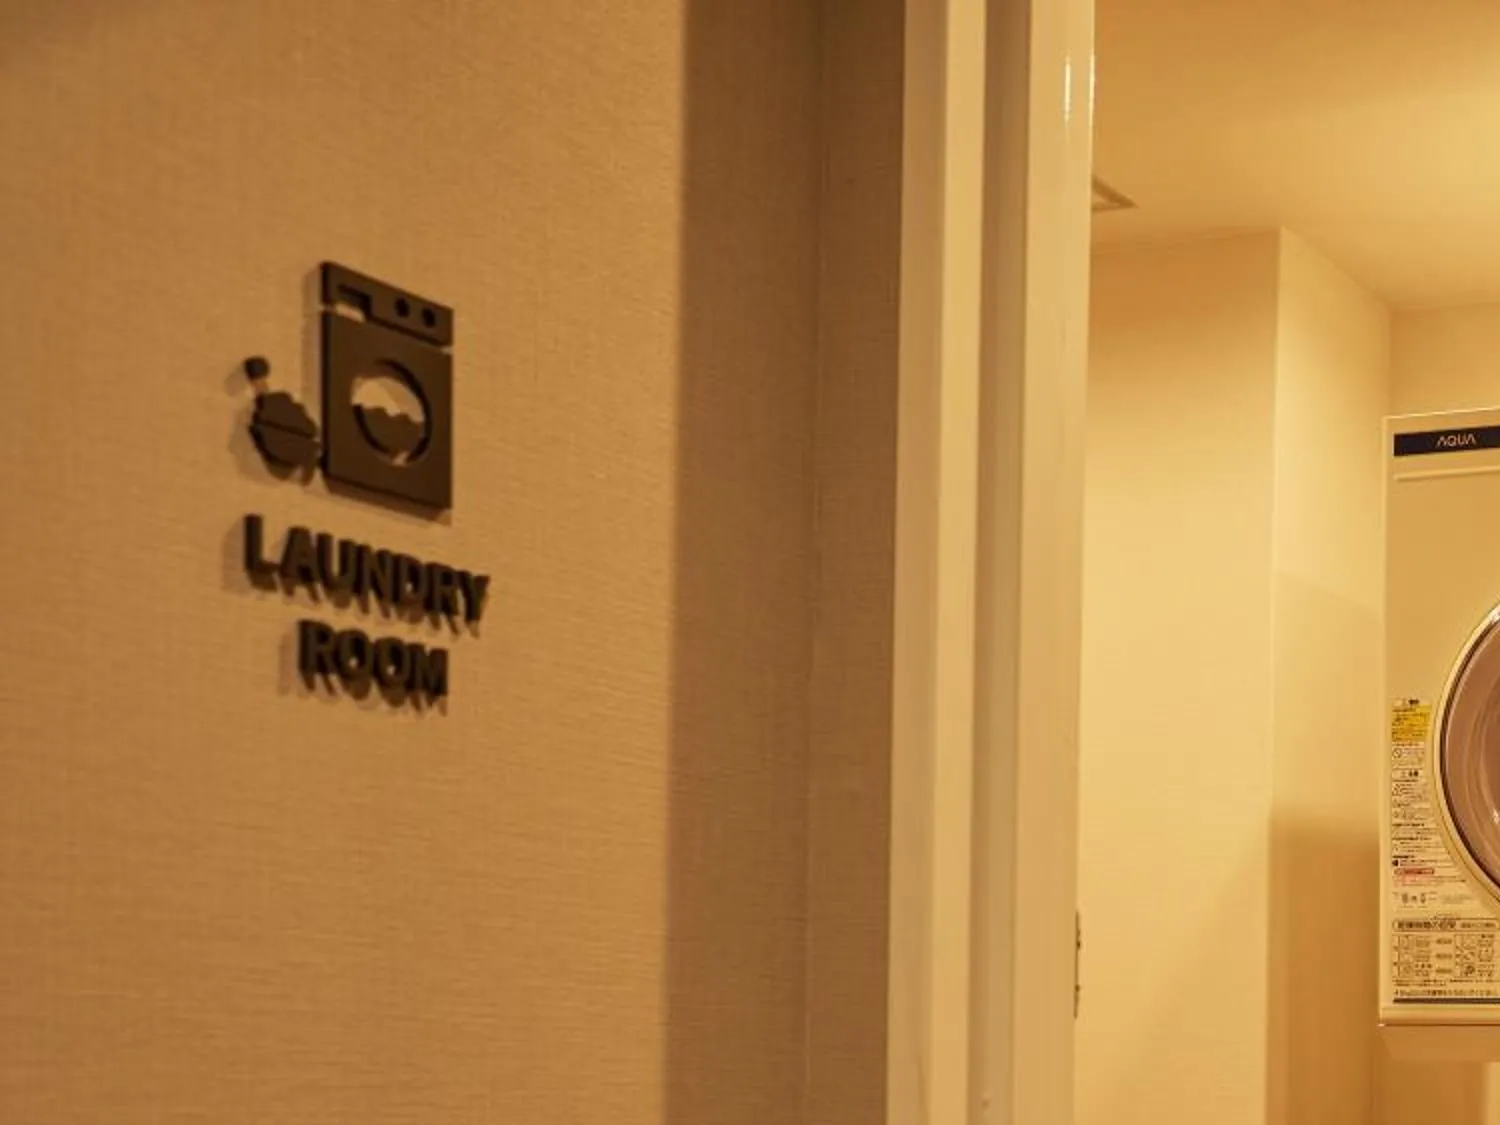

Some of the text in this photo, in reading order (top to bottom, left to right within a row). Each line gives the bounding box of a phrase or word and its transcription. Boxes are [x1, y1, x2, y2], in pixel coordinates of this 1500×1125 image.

[1435, 433, 1477, 448] AQUA
[244, 513, 490, 630] LAUNDRY
[297, 619, 448, 704] ROOM
